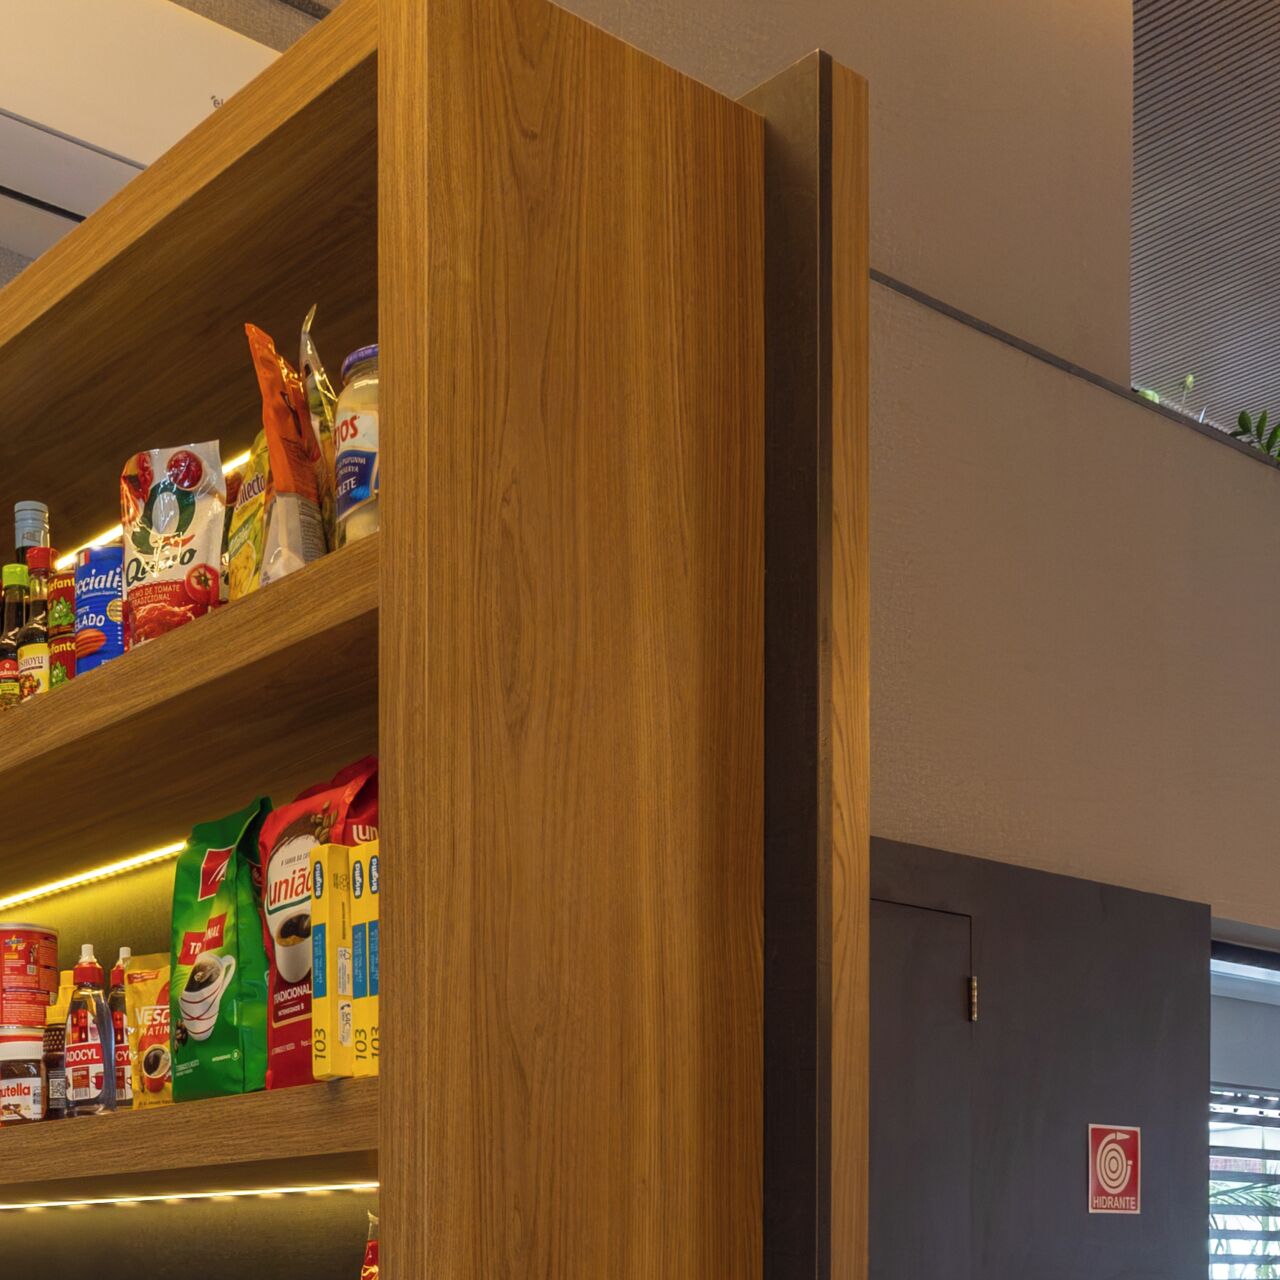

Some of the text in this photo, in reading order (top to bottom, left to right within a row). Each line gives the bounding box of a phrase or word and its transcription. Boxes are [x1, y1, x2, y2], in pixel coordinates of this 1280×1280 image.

[20, 656, 44, 669] SHOYU
[314, 1028, 326, 1061] 103
[355, 1028, 367, 1060] 103
[1093, 1196, 1136, 1210] HIDRANTE
